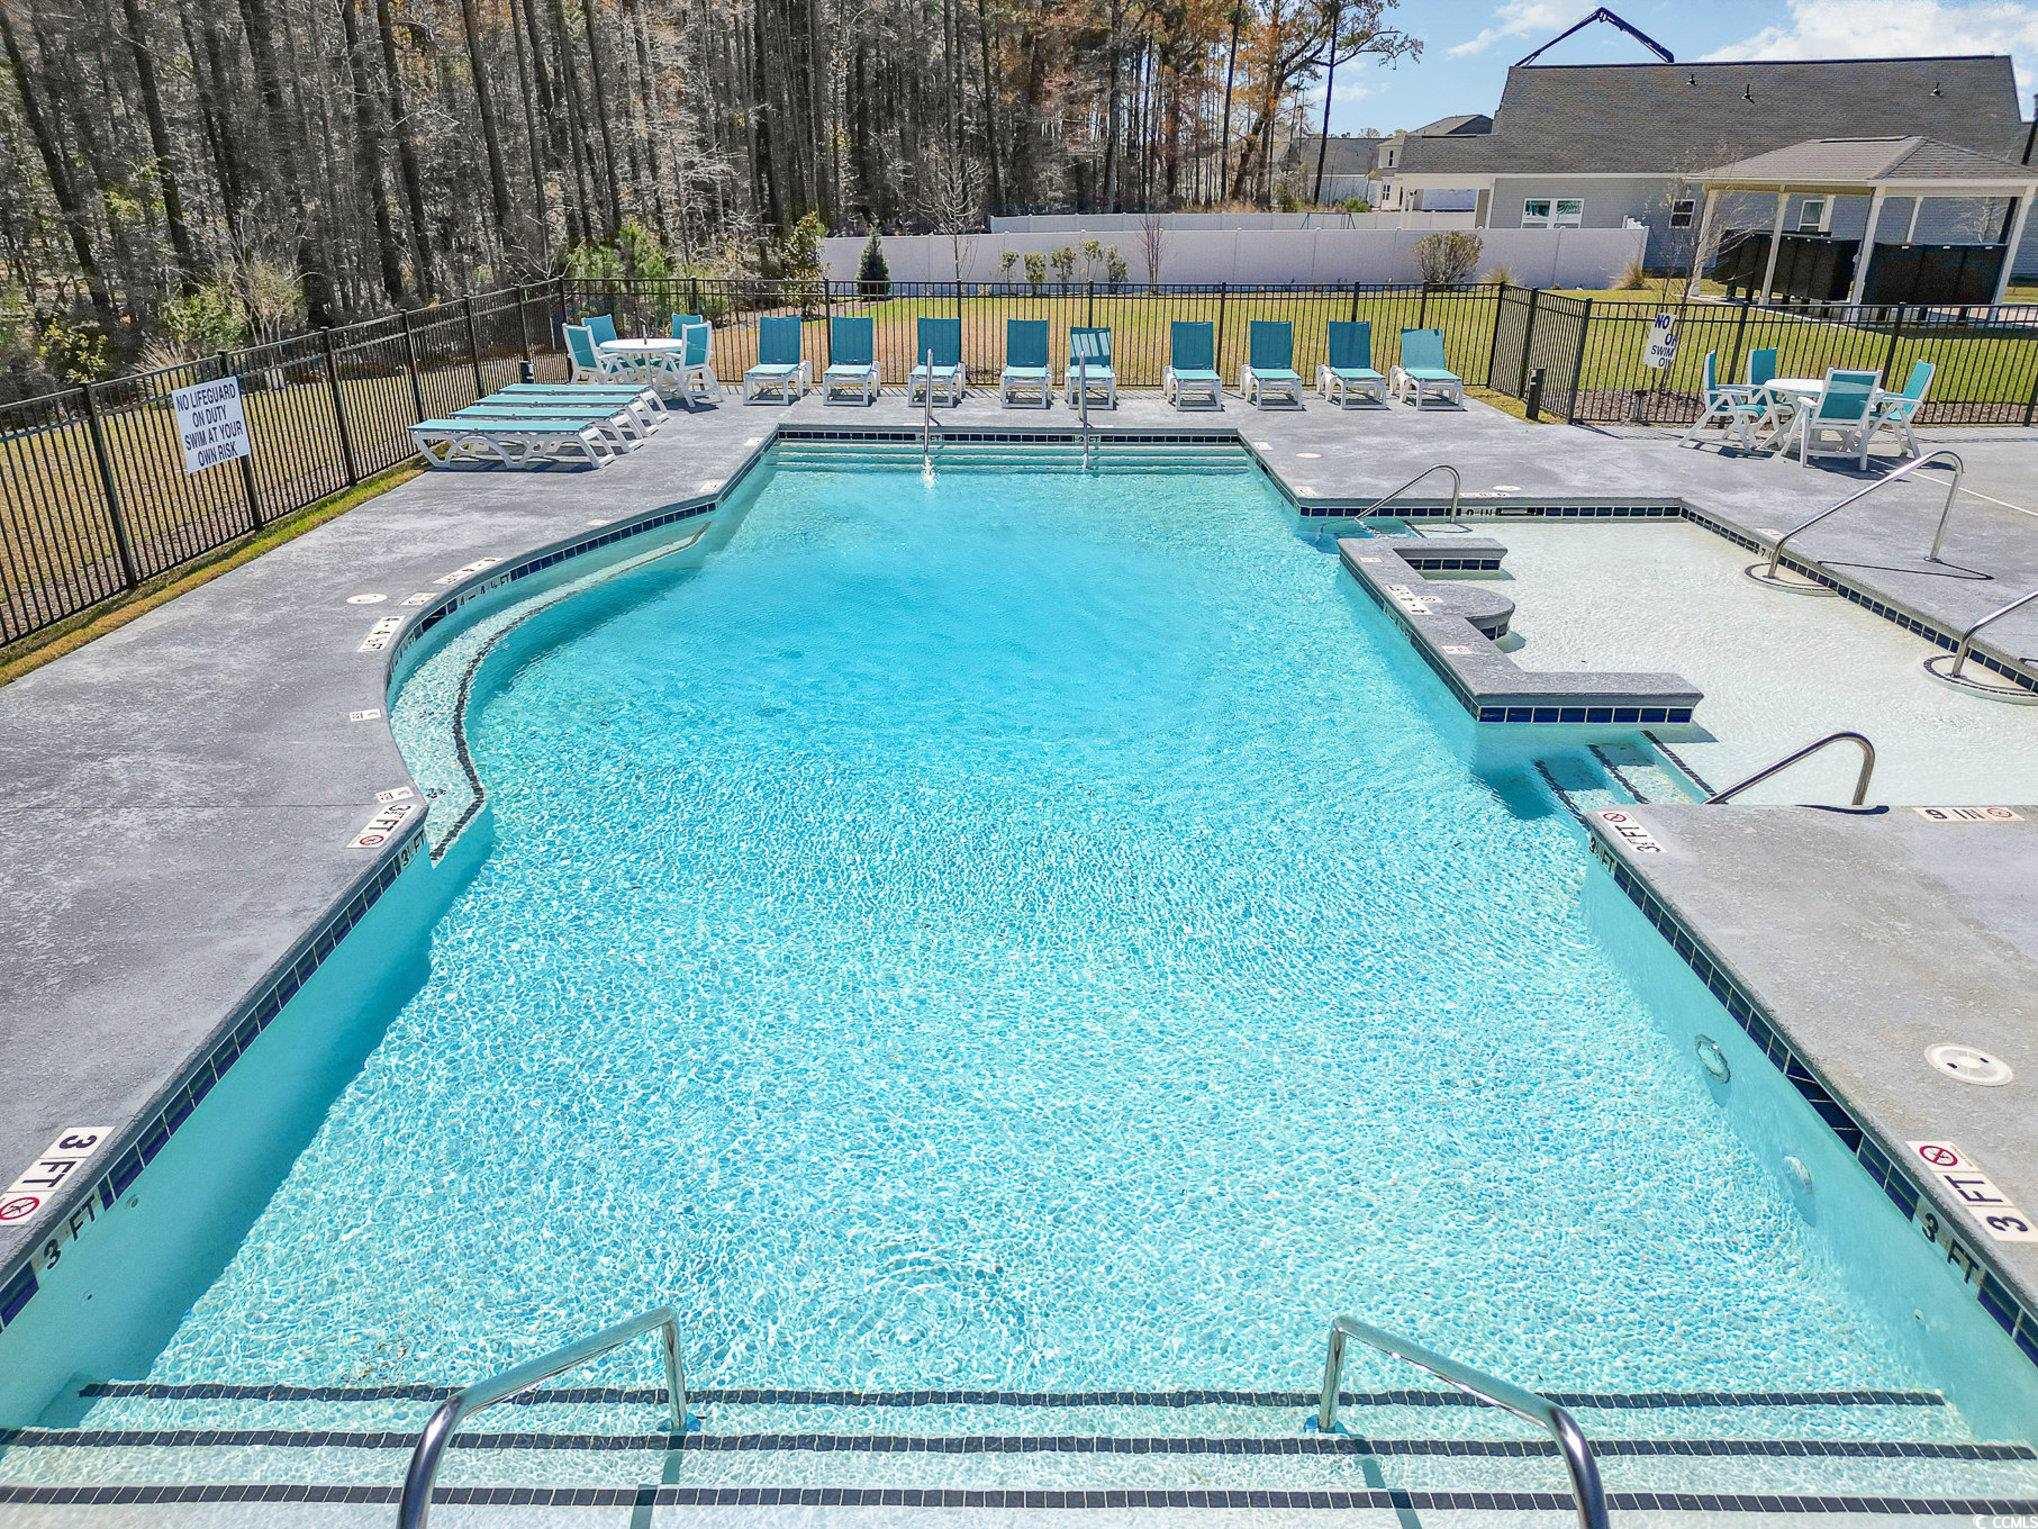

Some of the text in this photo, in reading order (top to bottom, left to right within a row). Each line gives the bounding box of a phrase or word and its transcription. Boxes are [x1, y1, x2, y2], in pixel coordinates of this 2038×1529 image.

[1655, 314, 1670, 329] NO
[176, 383, 236, 412] NO LIFEGUARD
[192, 404, 227, 428] ON DUTY
[184, 420, 244, 451] SWIM AT YOUR
[197, 441, 238, 467] OWN RISK
[22, 1134, 98, 1188] 3 FT
[1943, 1174, 2003, 1203] FT
[43, 1193, 96, 1270] 3 FT
[1986, 1215, 2029, 1232] 3
[1922, 1212, 1979, 1285] 3 FT
